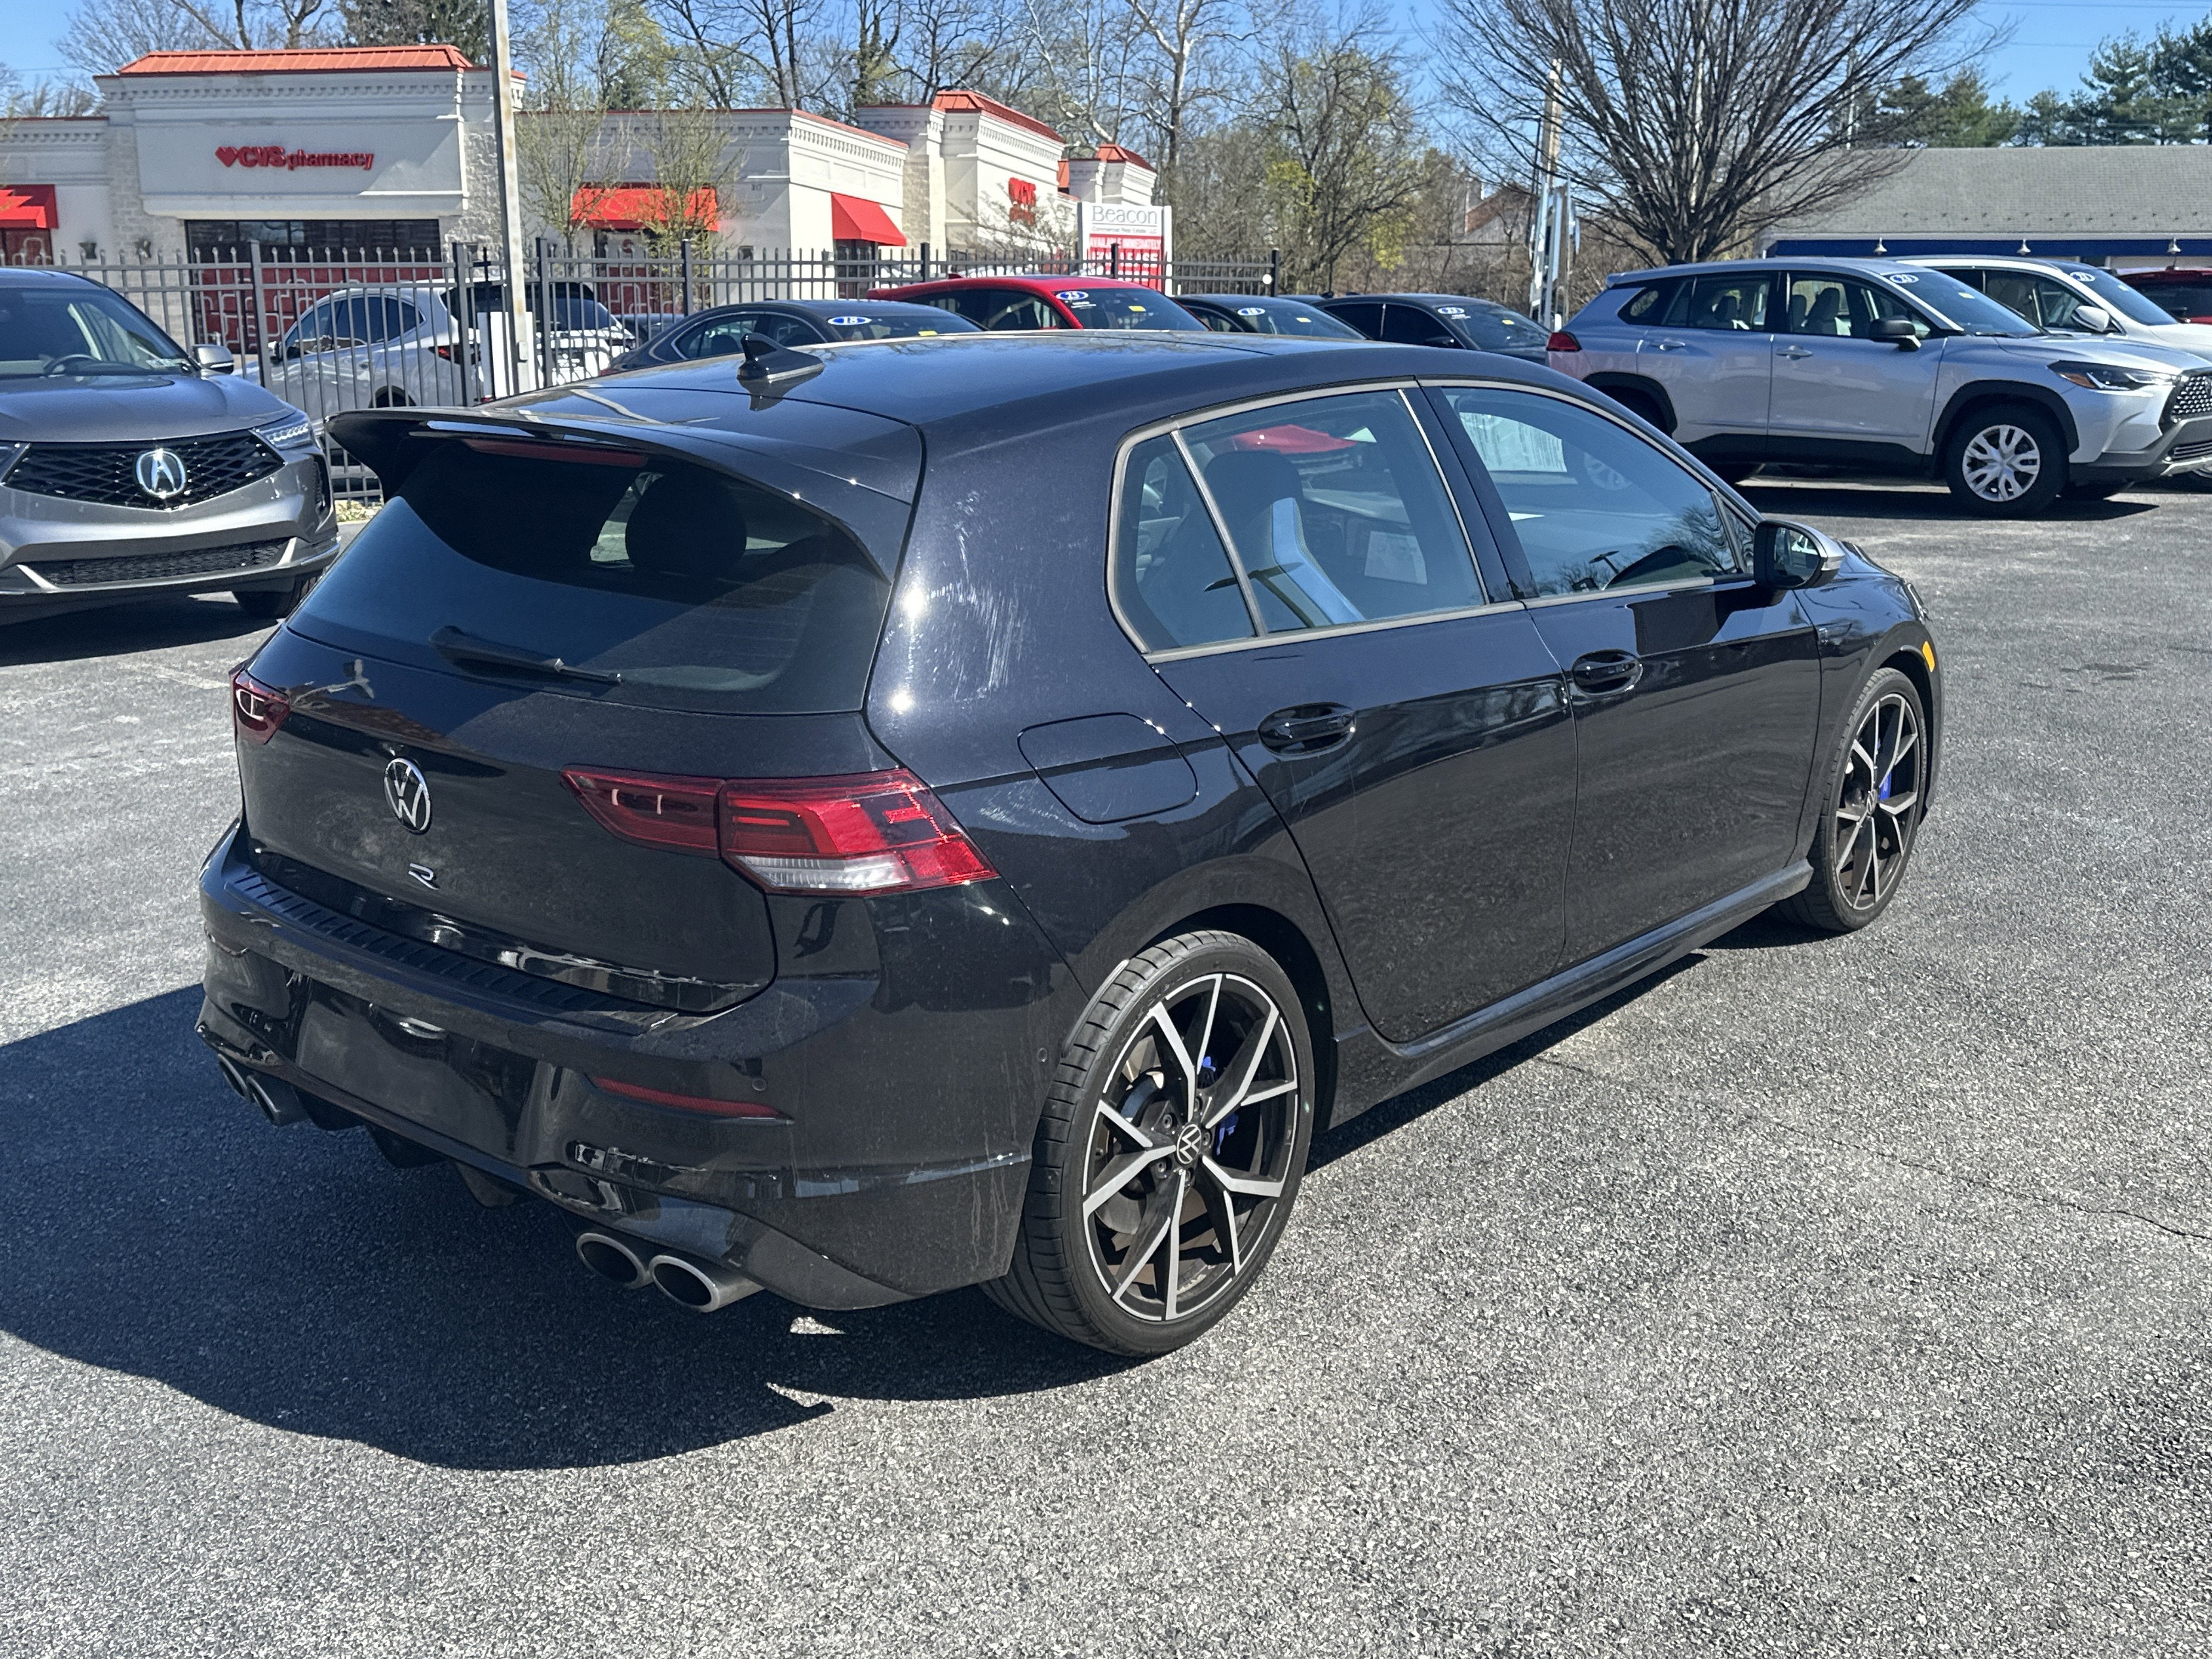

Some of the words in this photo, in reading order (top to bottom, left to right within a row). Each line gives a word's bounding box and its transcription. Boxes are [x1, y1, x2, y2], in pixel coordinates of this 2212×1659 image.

[238, 146, 286, 167] CVS
[287, 149, 374, 171] pharmacy
[1092, 206, 1157, 224] Beacon
[1064, 291, 1080, 300] 25
[843, 317, 858, 325] 18
[408, 862, 439, 890] R
